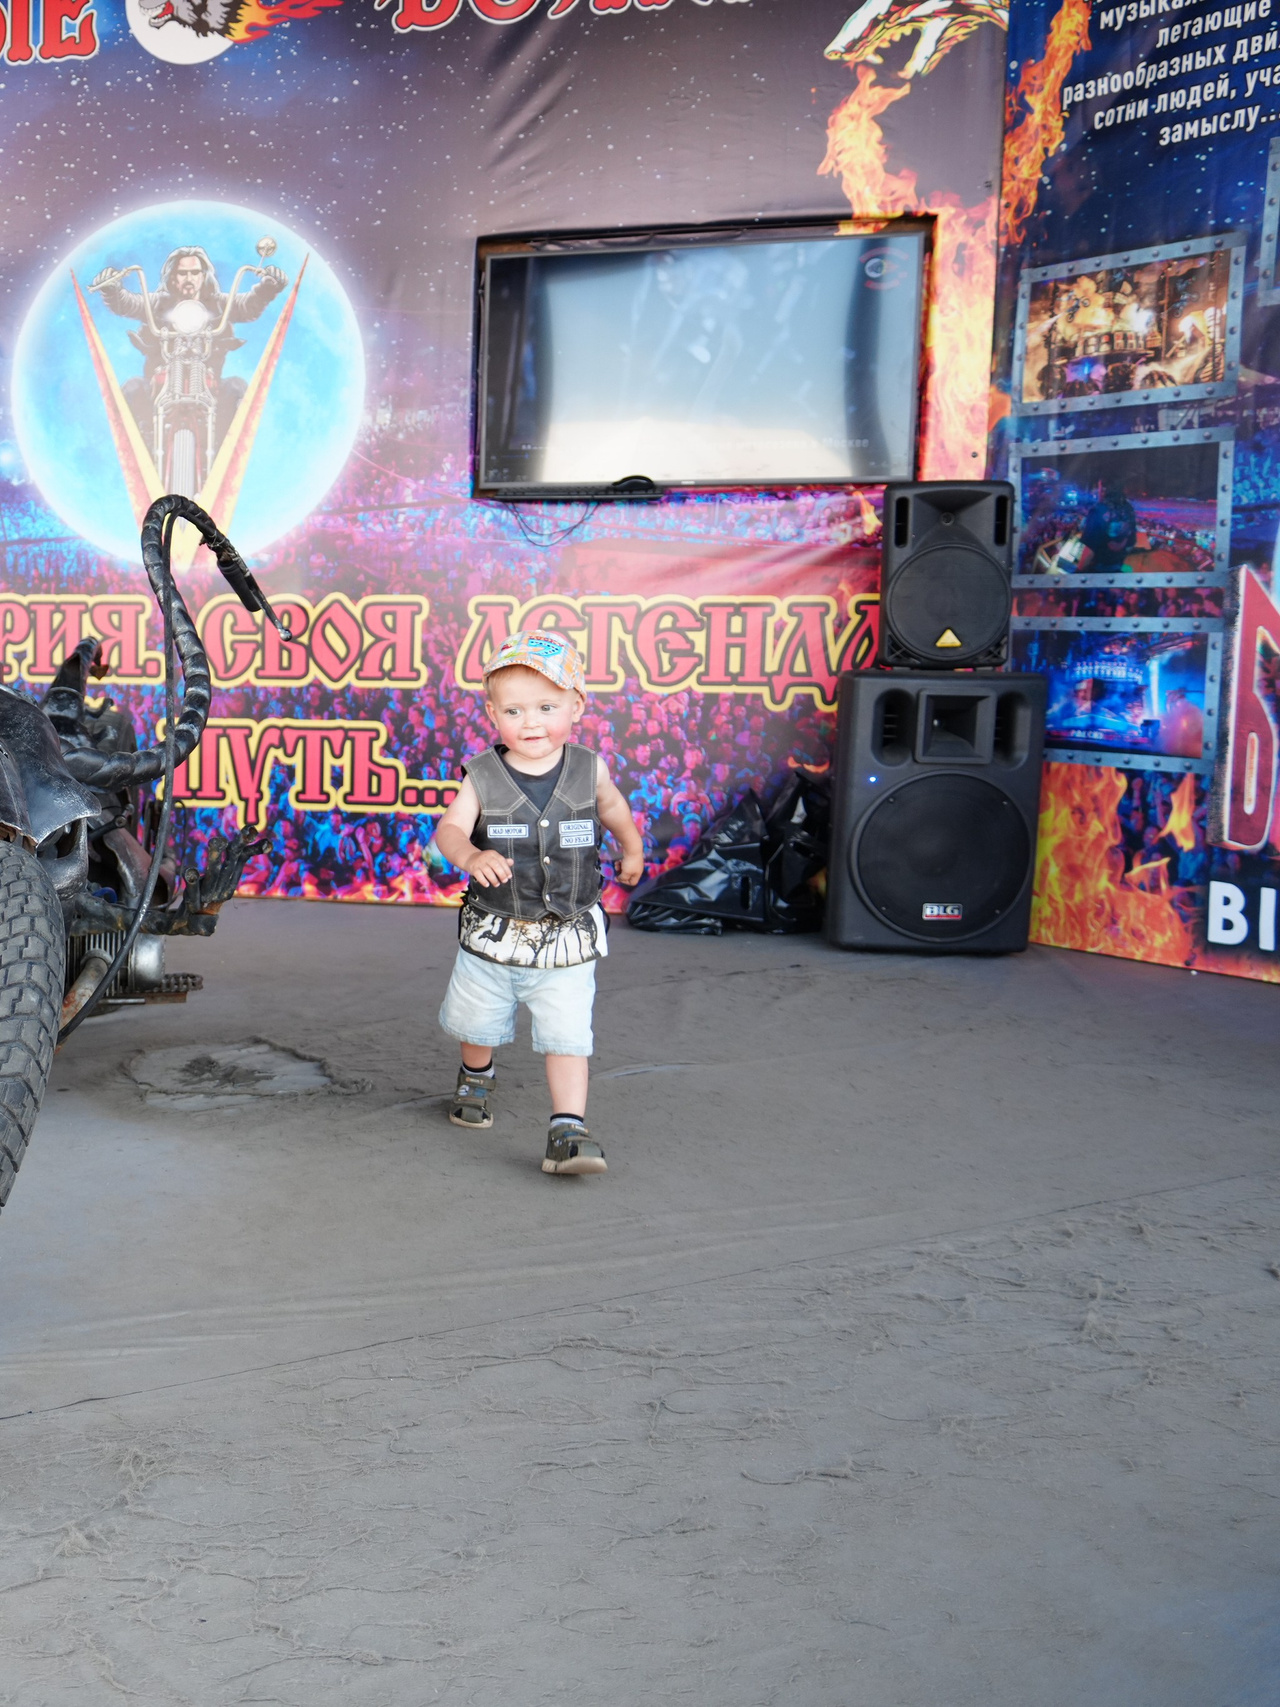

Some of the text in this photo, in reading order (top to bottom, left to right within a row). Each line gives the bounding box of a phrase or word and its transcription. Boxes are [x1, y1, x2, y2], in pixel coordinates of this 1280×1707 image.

[1155, 0, 1271, 48] летающие
[1062, 29, 1280, 110] разнообразных дви
[1093, 97, 1149, 130] сотни
[1154, 72, 1237, 114] людей,
[201, 599, 424, 684] СВОЯ
[563, 822, 589, 830] ORIGINAL
